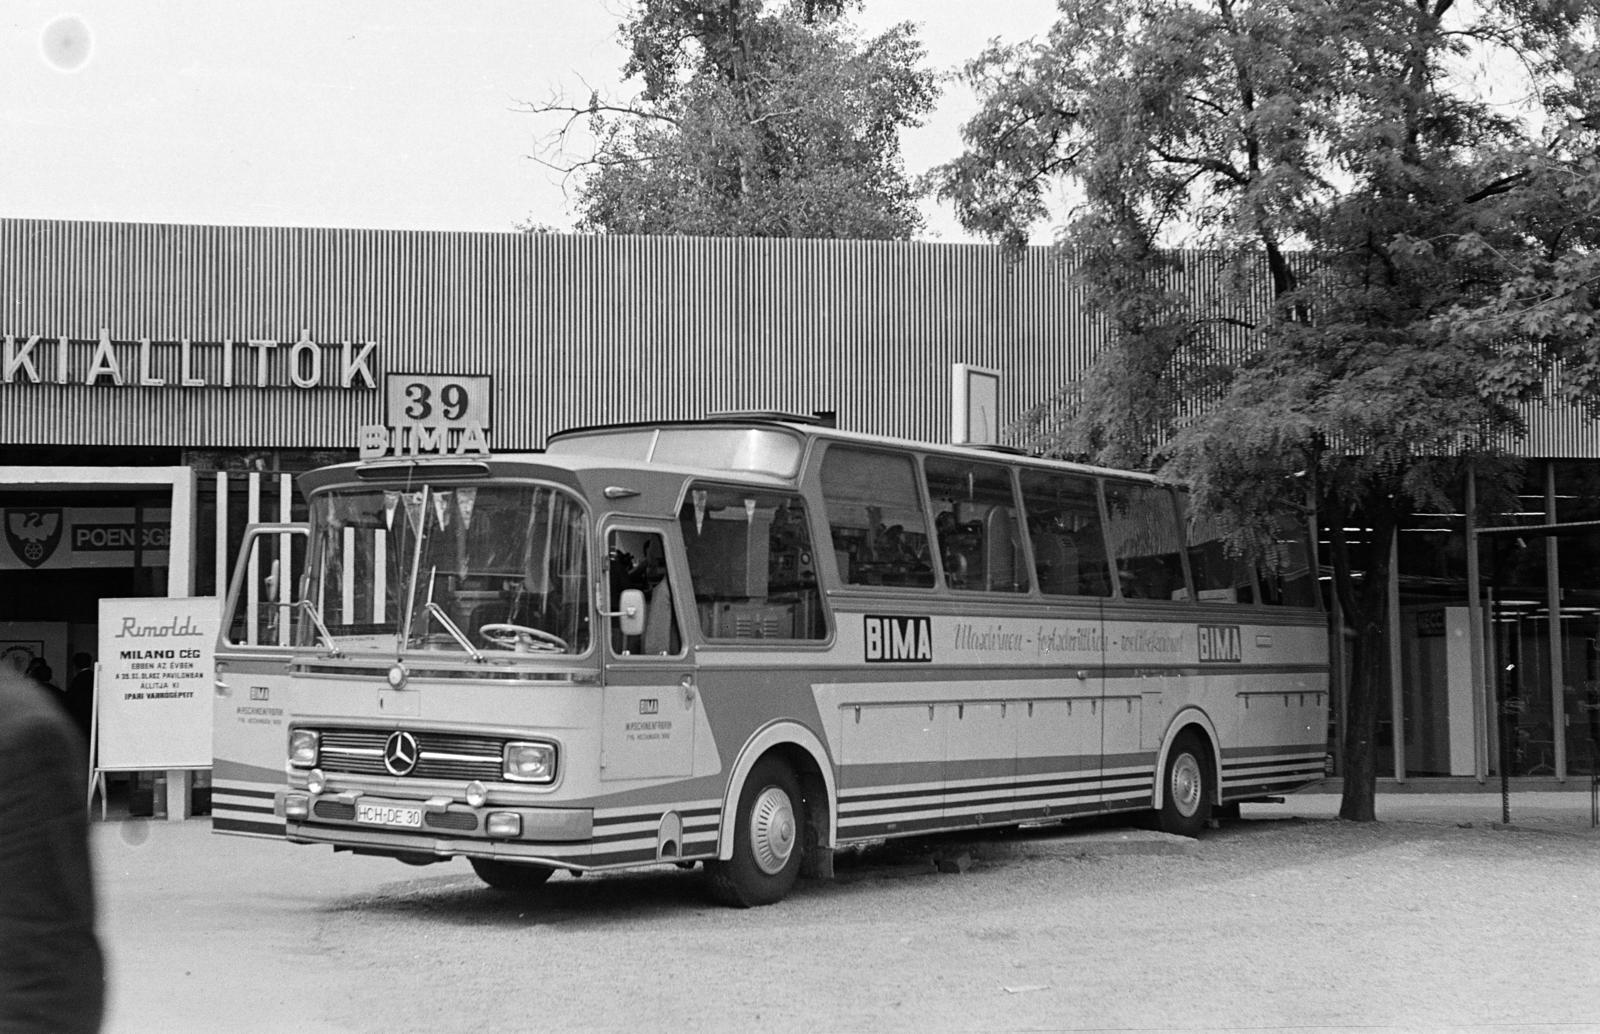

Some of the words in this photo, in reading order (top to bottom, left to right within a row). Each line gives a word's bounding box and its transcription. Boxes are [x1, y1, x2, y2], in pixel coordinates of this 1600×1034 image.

[405, 383, 468, 420] 39
[360, 420, 490, 458] BIMA
[115, 616, 203, 638] Rimoldi
[866, 618, 932, 660] BIMA
[1200, 626, 1241, 661] BIMA
[120, 650, 175, 659] MILANO
[179, 647, 200, 659] CÉG
[359, 807, 403, 823] HCH-DE
[406, 811, 420, 825] 30
